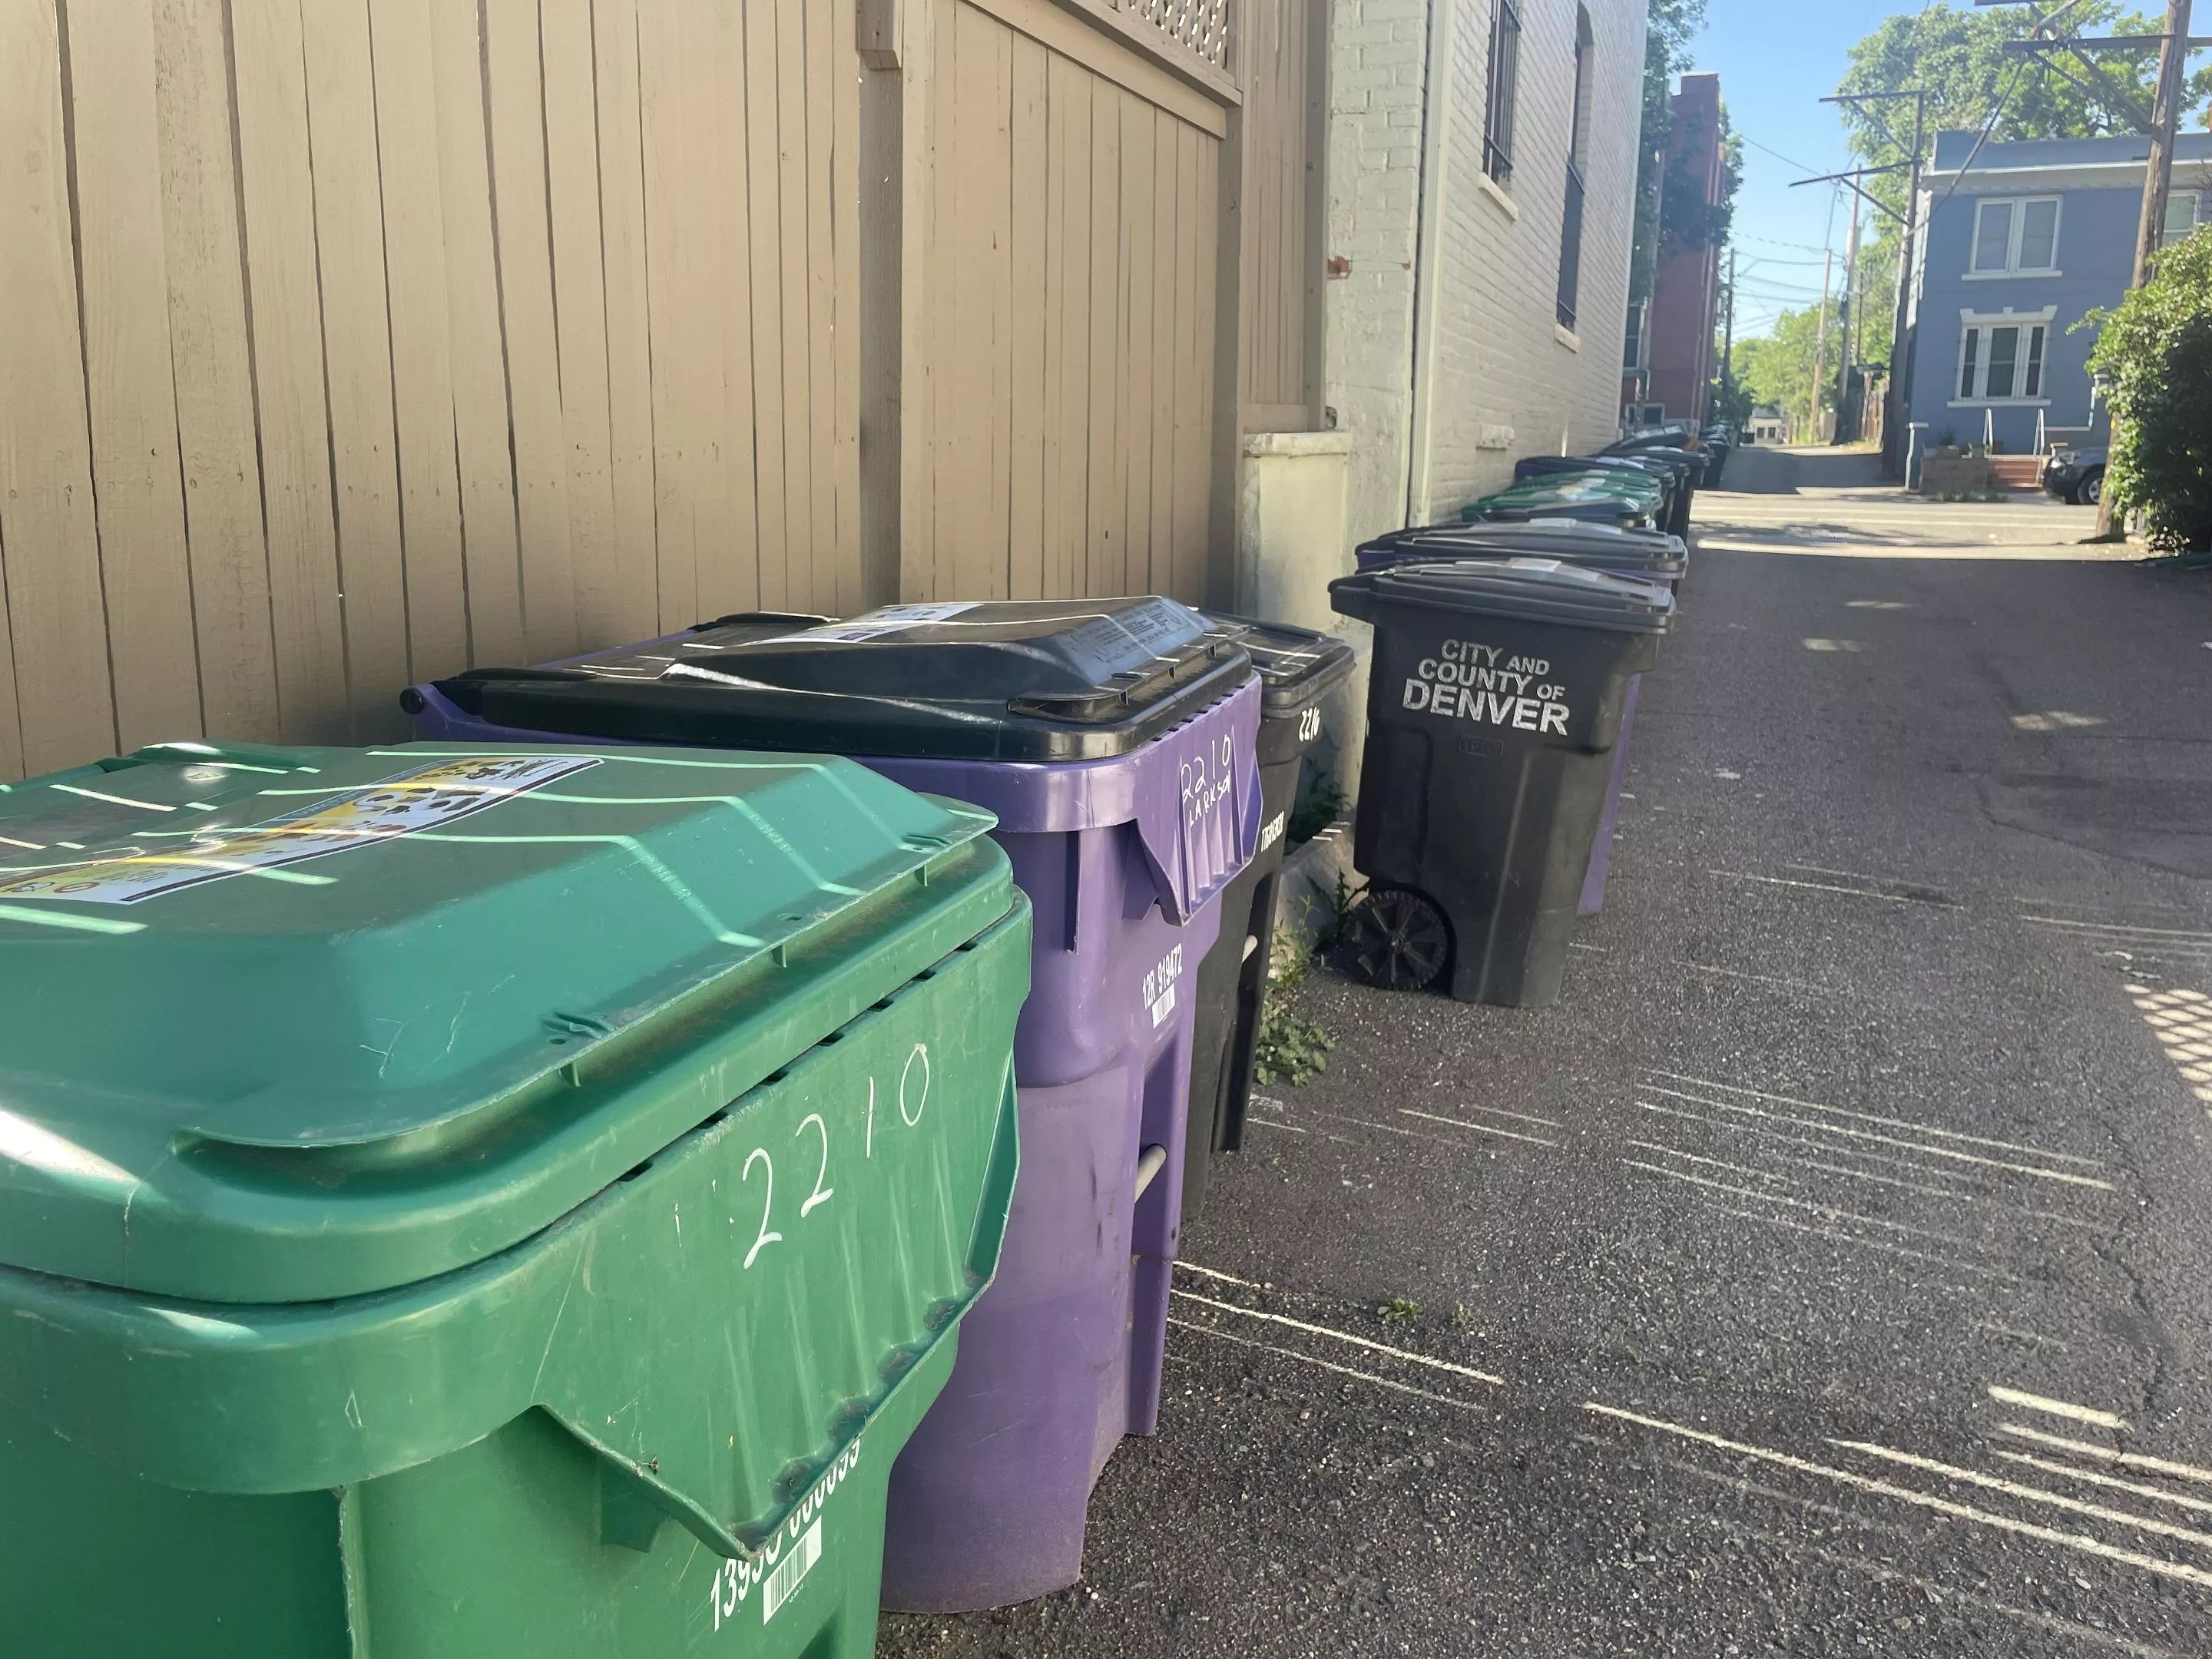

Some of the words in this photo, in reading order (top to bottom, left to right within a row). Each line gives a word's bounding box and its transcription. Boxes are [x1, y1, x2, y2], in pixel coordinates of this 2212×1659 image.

[1418, 658, 1533, 695] COUNTY
[1536, 684, 1565, 700] OF
[1441, 638, 1503, 667] CITY
[1506, 655, 1550, 676] AND
[1402, 678, 1570, 736] DENVER
[1181, 733, 1231, 805] 2210
[1142, 969, 1156, 1010] 12R
[1157, 942, 1182, 994] 919472
[742, 1042, 930, 1270] 2210
